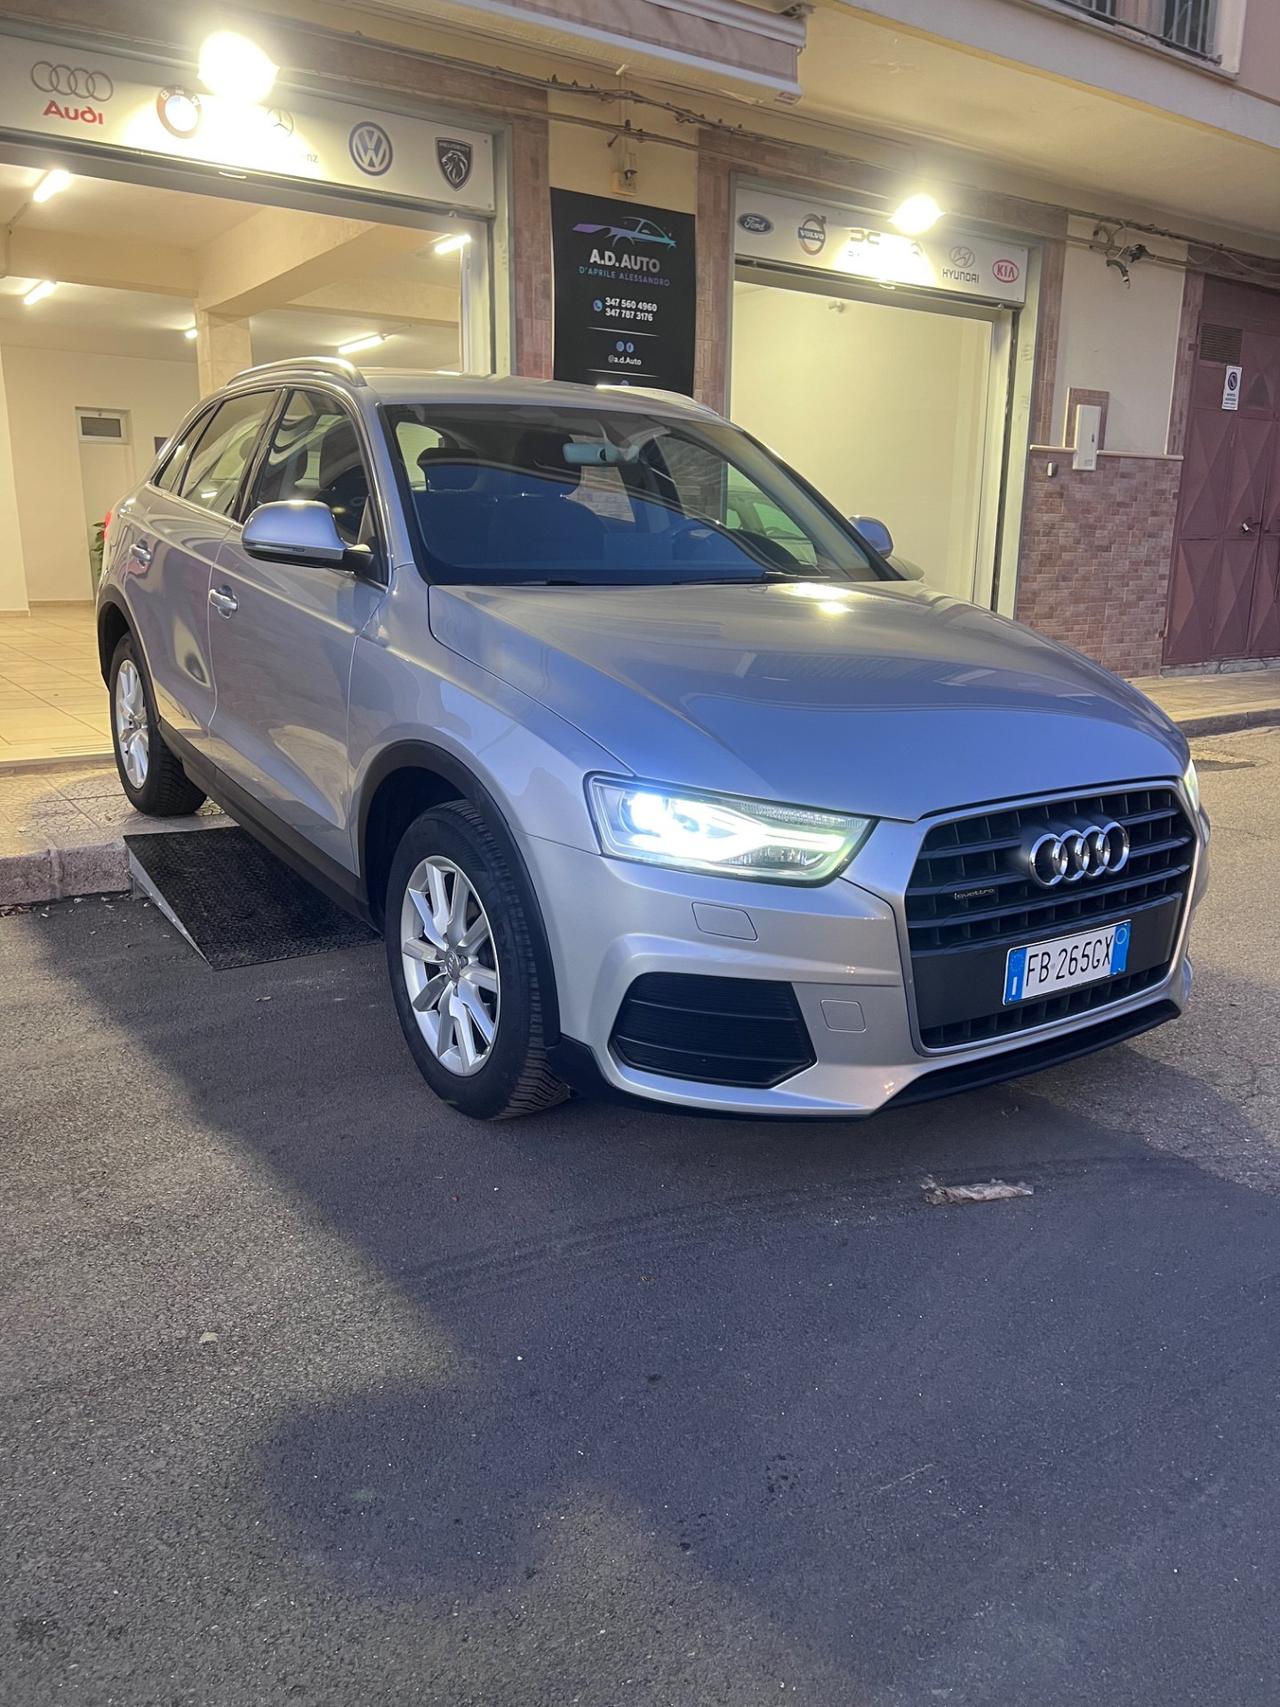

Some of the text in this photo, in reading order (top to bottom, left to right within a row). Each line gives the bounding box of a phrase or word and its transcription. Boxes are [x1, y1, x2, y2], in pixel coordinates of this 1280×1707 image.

[42, 100, 104, 125] Audi
[744, 216, 767, 231] Ford
[800, 229, 824, 240] VOLVO
[942, 268, 980, 284] HYUNDAI
[997, 263, 1015, 279] KIA
[619, 272, 671, 287] ALESSANDRO
[605, 297, 620, 307] 347
[605, 307, 620, 317] 347
[636, 311, 653, 322] 3176
[1026, 935, 1113, 987] FB 265GX
